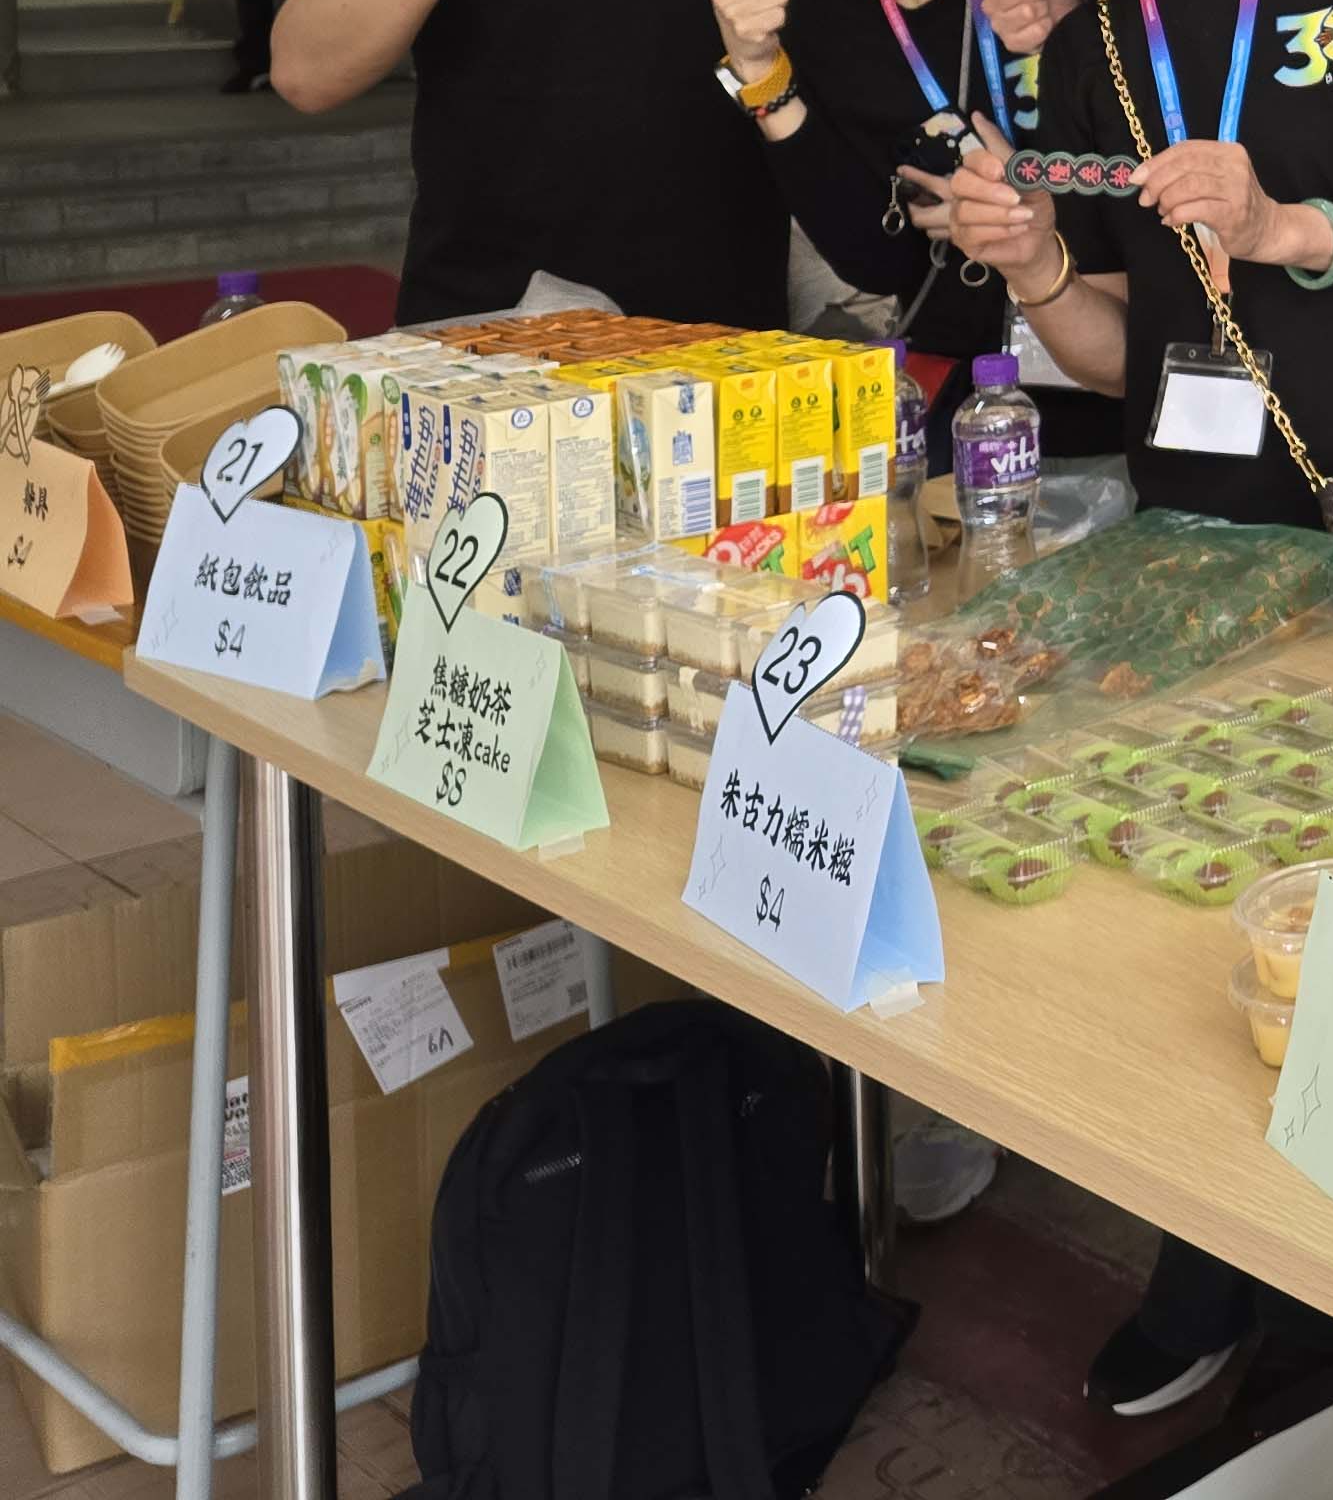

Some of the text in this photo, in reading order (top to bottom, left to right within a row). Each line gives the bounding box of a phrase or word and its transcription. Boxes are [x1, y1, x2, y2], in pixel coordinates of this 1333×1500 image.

[216, 437, 264, 484] 21
[404, 404, 436, 524] 維他奶
[192, 552, 295, 608] 紙包飲品
[434, 528, 478, 590] 22
[213, 618, 246, 659] $4
[762, 626, 823, 696] 23
[430, 654, 514, 726] 焦糖奶茶
[412, 705, 513, 776] 芝士凍cake
[435, 760, 469, 808] $8
[719, 768, 856, 888] 朱古力糯米糍
[754, 875, 786, 933] $4
